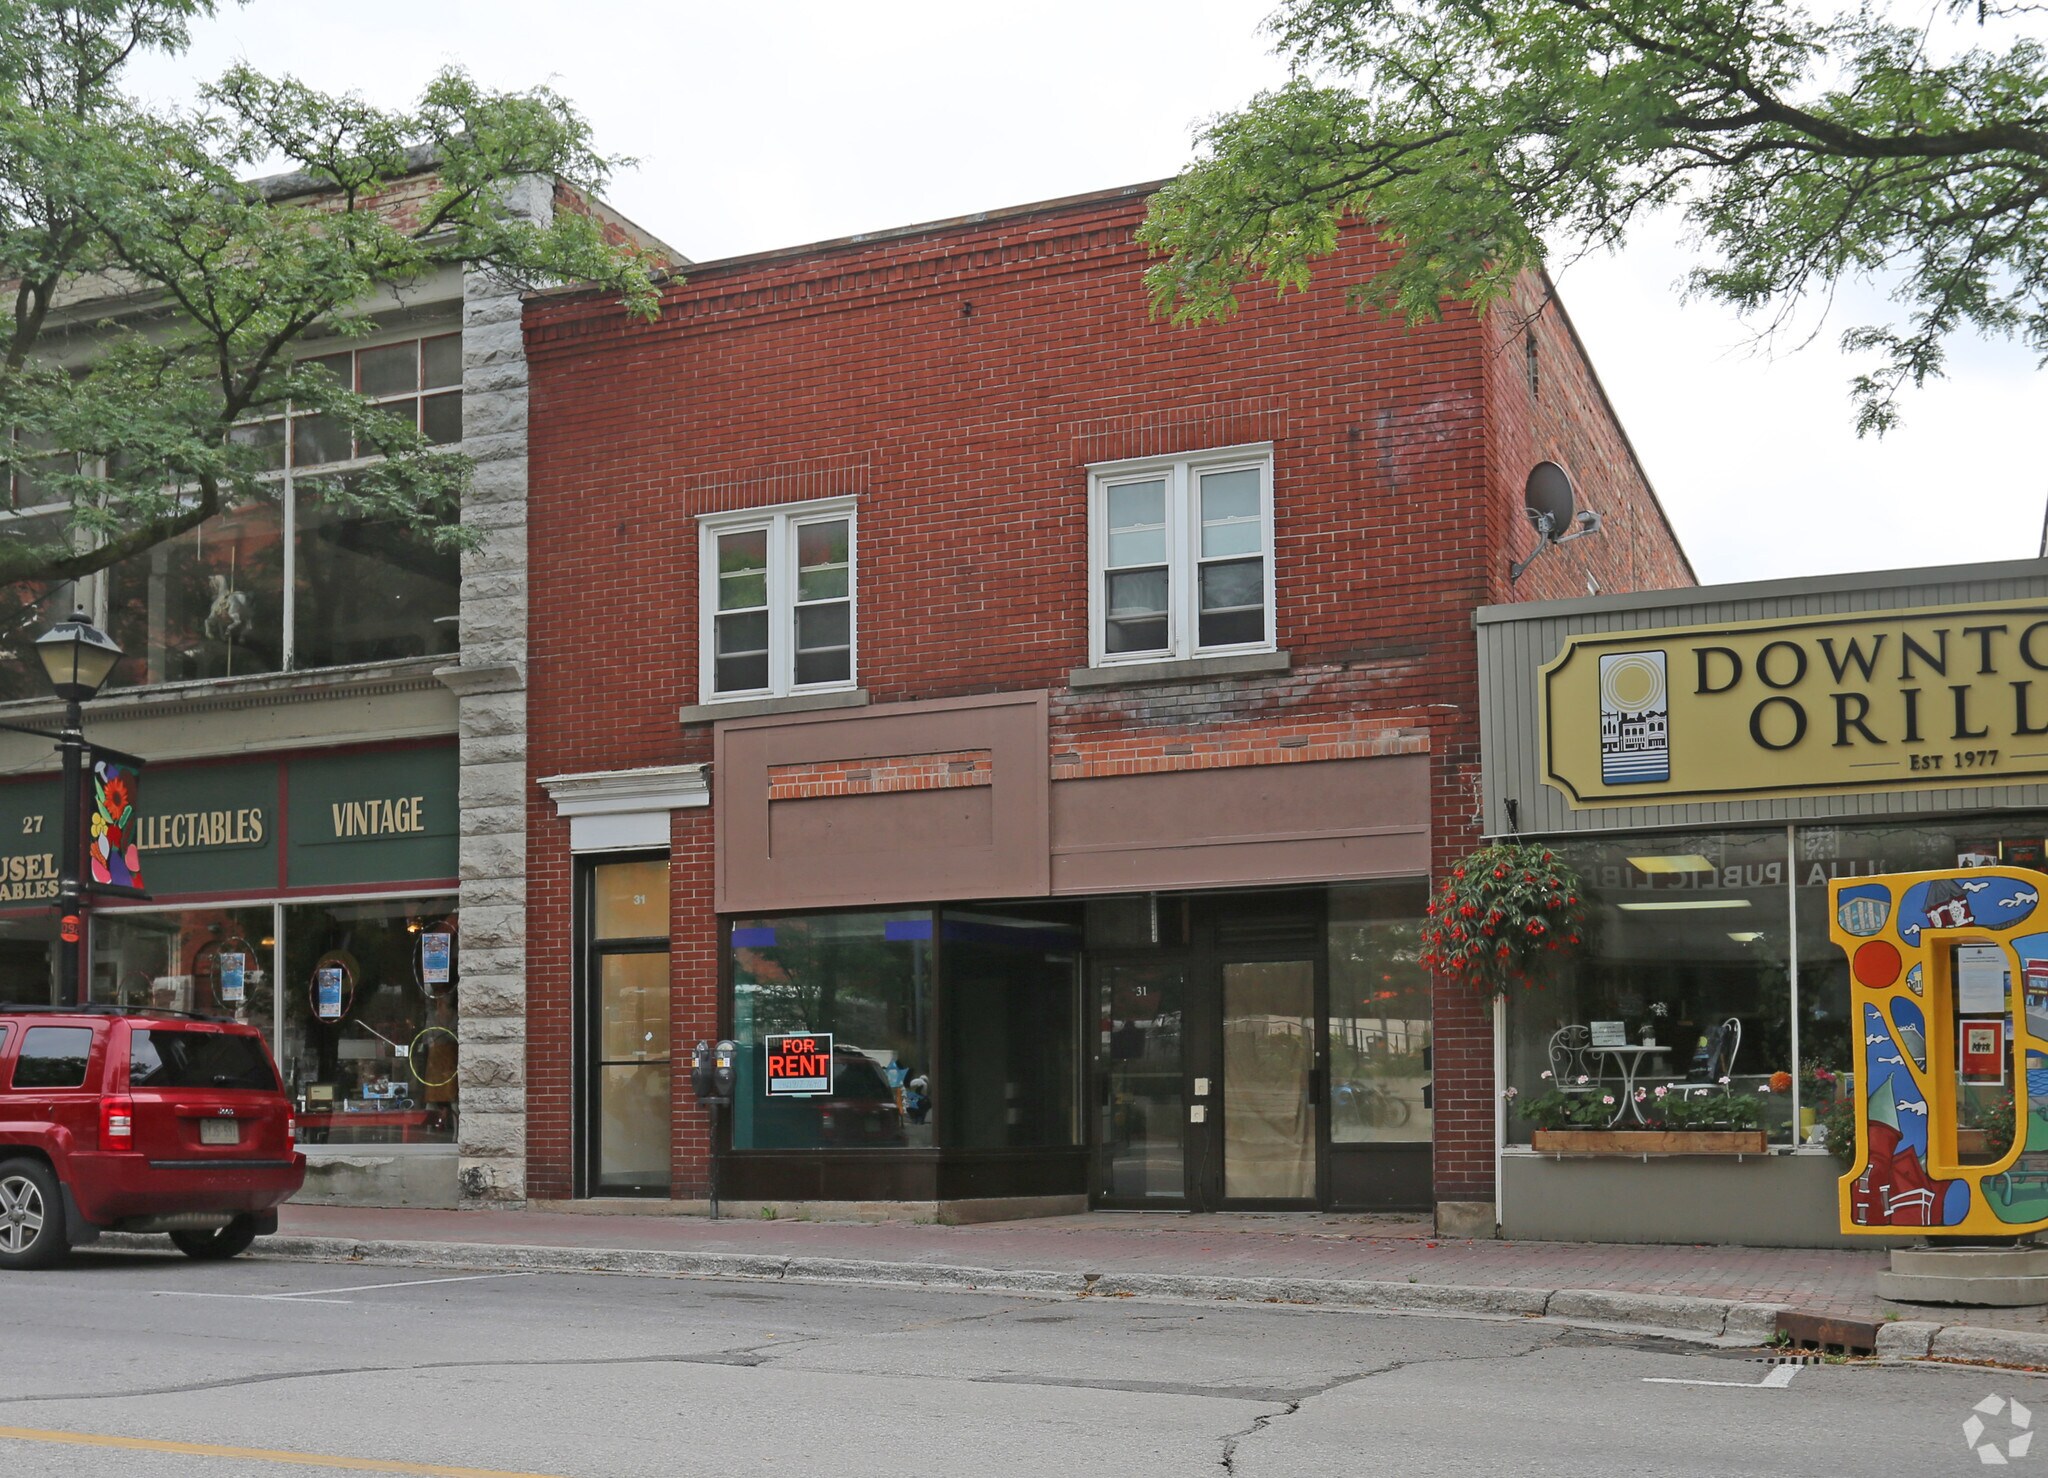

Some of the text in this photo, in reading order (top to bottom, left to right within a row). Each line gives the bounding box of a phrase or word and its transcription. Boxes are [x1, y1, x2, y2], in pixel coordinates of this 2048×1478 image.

[1749, 680, 2048, 751] ORILL
[1954, 749, 1999, 769] 1977
[23, 815, 43, 834] 27
[332, 796, 425, 837] VINTAGE
[633, 894, 646, 905] 31
[1135, 986, 1147, 997] 31
[782, 1038, 815, 1054] FOR
[769, 1054, 830, 1077] RENT
